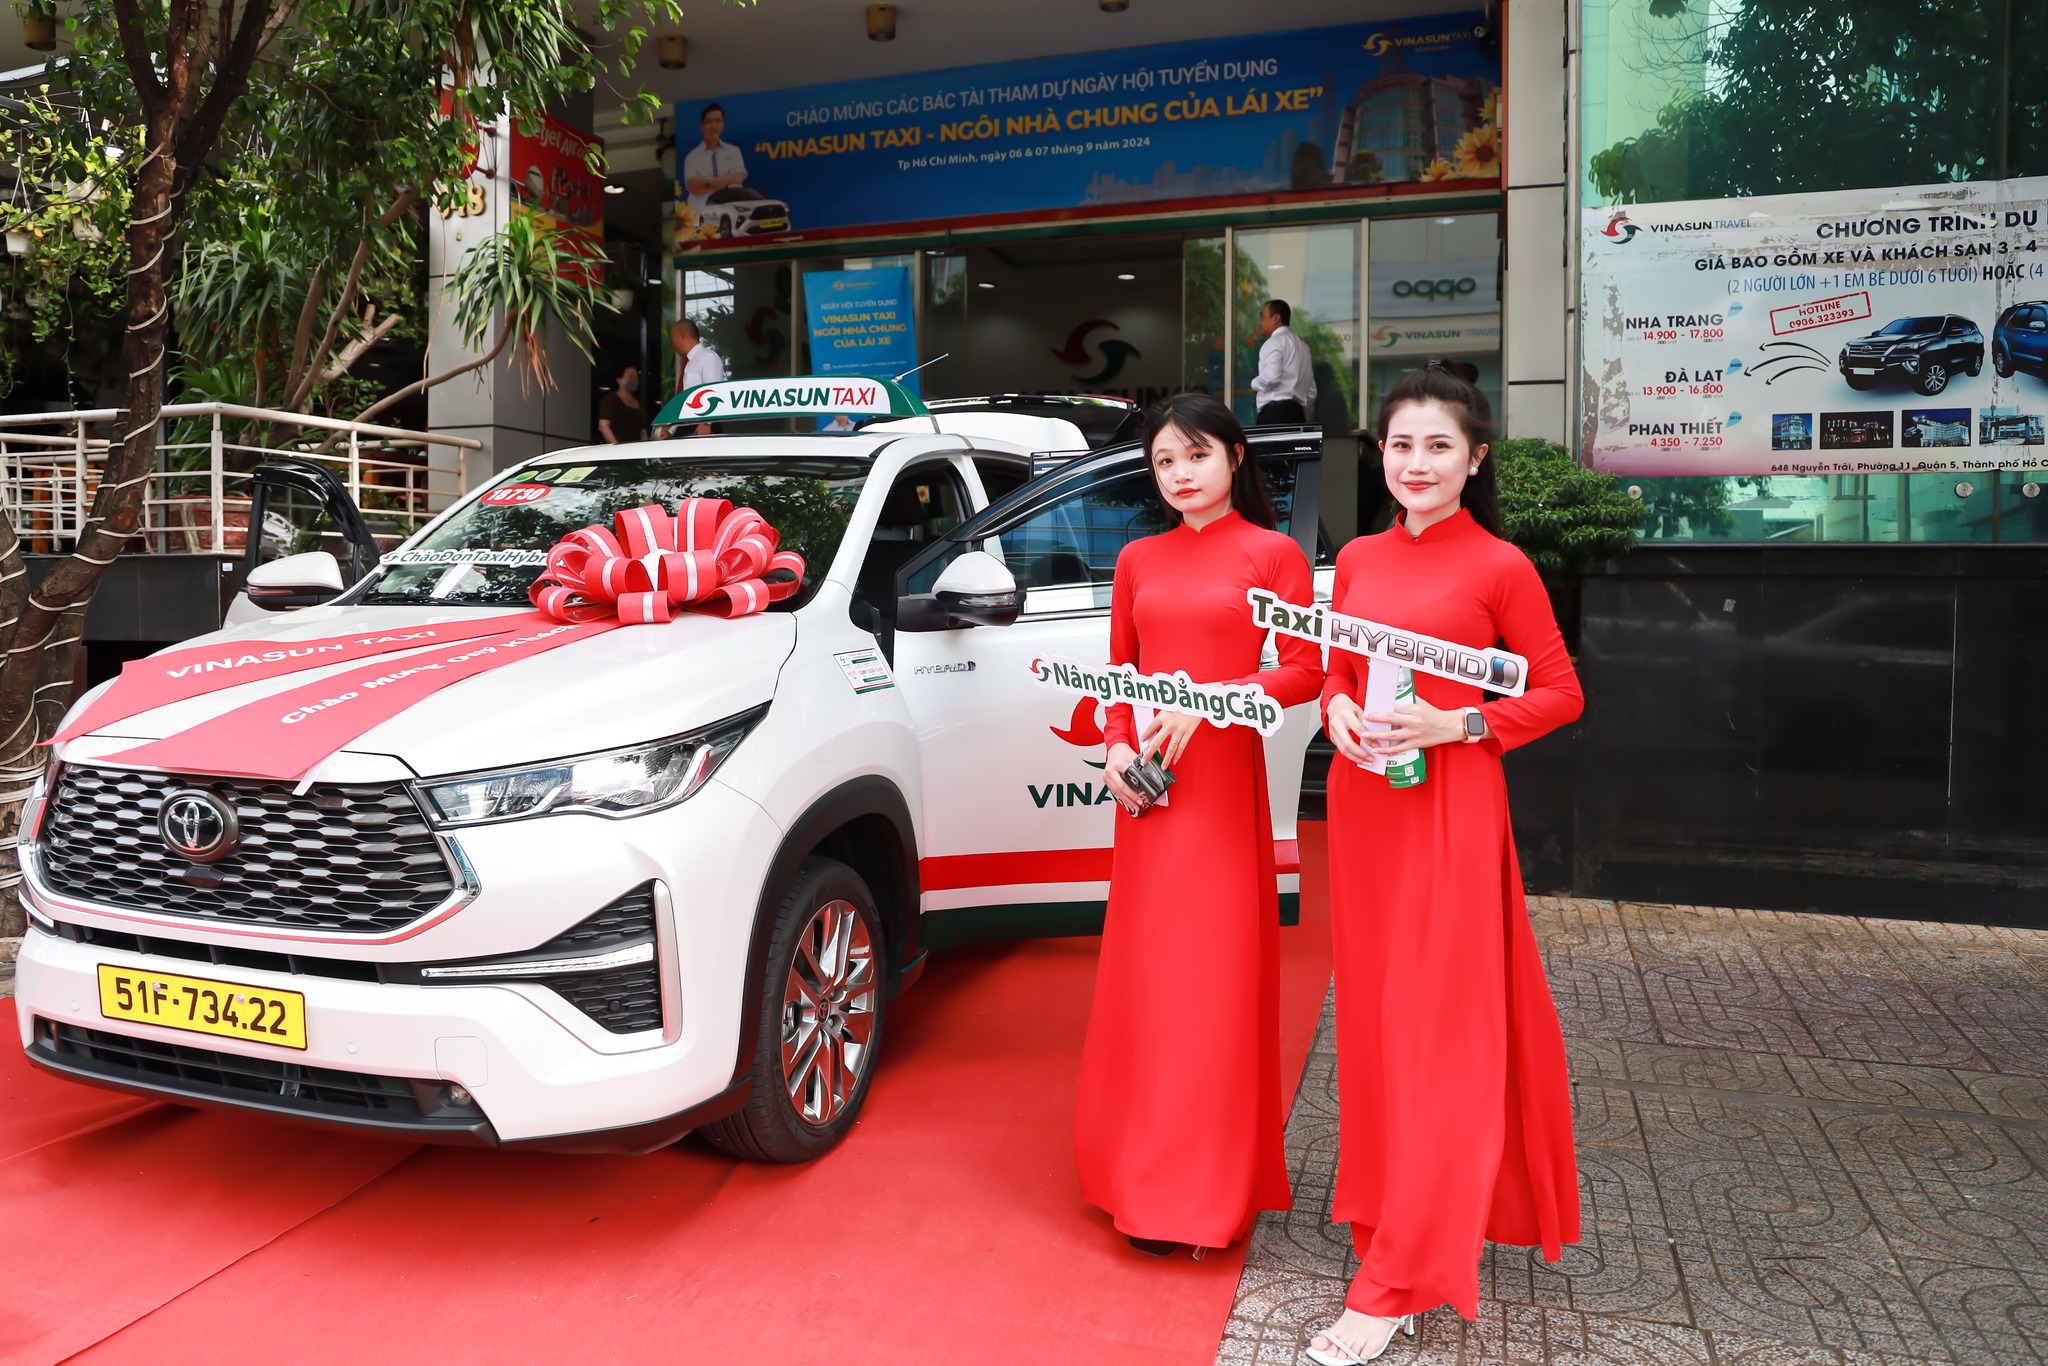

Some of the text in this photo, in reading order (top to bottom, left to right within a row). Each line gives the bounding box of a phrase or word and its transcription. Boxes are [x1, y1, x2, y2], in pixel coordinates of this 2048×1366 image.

[785, 58, 1278, 127] CHÀO MỪNG CÁC BÁC TÀI THAM DỰ NGÀY HỘI TUYỂN DỤNG
[870, 126, 921, 149] TAXI
[940, 114, 1000, 142] NGÔI
[1006, 108, 1061, 136] NHÀ
[1066, 102, 1158, 130] CHUNG
[1164, 91, 1220, 120] CỦA
[1226, 88, 1268, 116] LÁI
[898, 159, 910, 171] Tp
[929, 155, 946, 166] Chí
[949, 153, 978, 164] Minh,
[981, 150, 1006, 163] ngày
[1009, 148, 1022, 159] 06
[1025, 147, 1033, 157] &
[1035, 146, 1049, 157] 07
[1052, 143, 1084, 156] tháng
[1086, 141, 1093, 152] 9
[1095, 138, 1120, 150] năm
[1122, 136, 1150, 149] 2024
[1650, 218, 1751, 233] VINASUN TRAVEL
[1816, 216, 1921, 239] CHƯƠNG
[2005, 209, 2037, 228] DU
[1694, 254, 1725, 271] GIÁ
[1731, 255, 1768, 269] BAO
[1774, 247, 1817, 266] GỒM
[1823, 251, 1844, 265] XE
[1850, 246, 1875, 263] VÀ
[1882, 243, 1948, 261] KHÁCH
[1954, 242, 1991, 260] SẠN
[1998, 241, 2009, 255] 3
[2025, 239, 2037, 253] 4
[1727, 278, 1740, 295] (2
[1744, 274, 1786, 293] NGƯỜI
[1790, 273, 1816, 291] LỚN
[1844, 272, 1864, 288] EM
[1869, 269, 1885, 287] BÉ
[1889, 266, 1924, 286] DƯỚI
[1928, 268, 1936, 283] 6
[1937, 262, 1978, 283] TUỔI)
[1982, 261, 2025, 283] HOẶC
[2029, 263, 2044, 277] (4
[1799, 301, 1841, 316] HOTLINE
[822, 311, 897, 324] VINASUN TAXI
[1626, 313, 1723, 329] NHA TRANG
[1789, 308, 1855, 329] 0906.323393
[813, 323, 907, 337] NGÔI NHÀ CHUNG
[1405, 329, 1460, 340] VINASUN
[1643, 330, 1677, 341] 14.900
[1689, 328, 1724, 339] 17.800
[833, 335, 892, 348] CỦA LÁI XE
[1665, 367, 1723, 386] ĐÀ LẠT
[1642, 386, 1676, 396] 13.900
[1688, 384, 1723, 395] 16.800
[1629, 416, 1723, 436] PHAN THIẾT
[1650, 438, 1680, 448] 4.350
[1693, 436, 1723, 447] 7.250
[1771, 464, 1789, 472] 648
[1792, 461, 1830, 473] Nguyễn
[1833, 462, 1854, 472] Trãi,
[1857, 462, 1896, 473] Phường
[1918, 460, 1946, 471] Quận
[1950, 461, 1959, 470] 5,
[1963, 460, 1995, 469] Thành
[1998, 458, 2019, 470] phố
[2022, 457, 2037, 468] Hồ
[486, 487, 547, 501] 18730
[1252, 592, 1488, 681] Taxi HYBRID
[167, 629, 437, 681] VINASUN TAXI
[280, 691, 359, 725] Chào
[446, 644, 498, 664] Quý
[499, 623, 582, 648] Khách
[913, 662, 969, 674] HYBRID
[115, 976, 288, 1036] 51F-734.22
